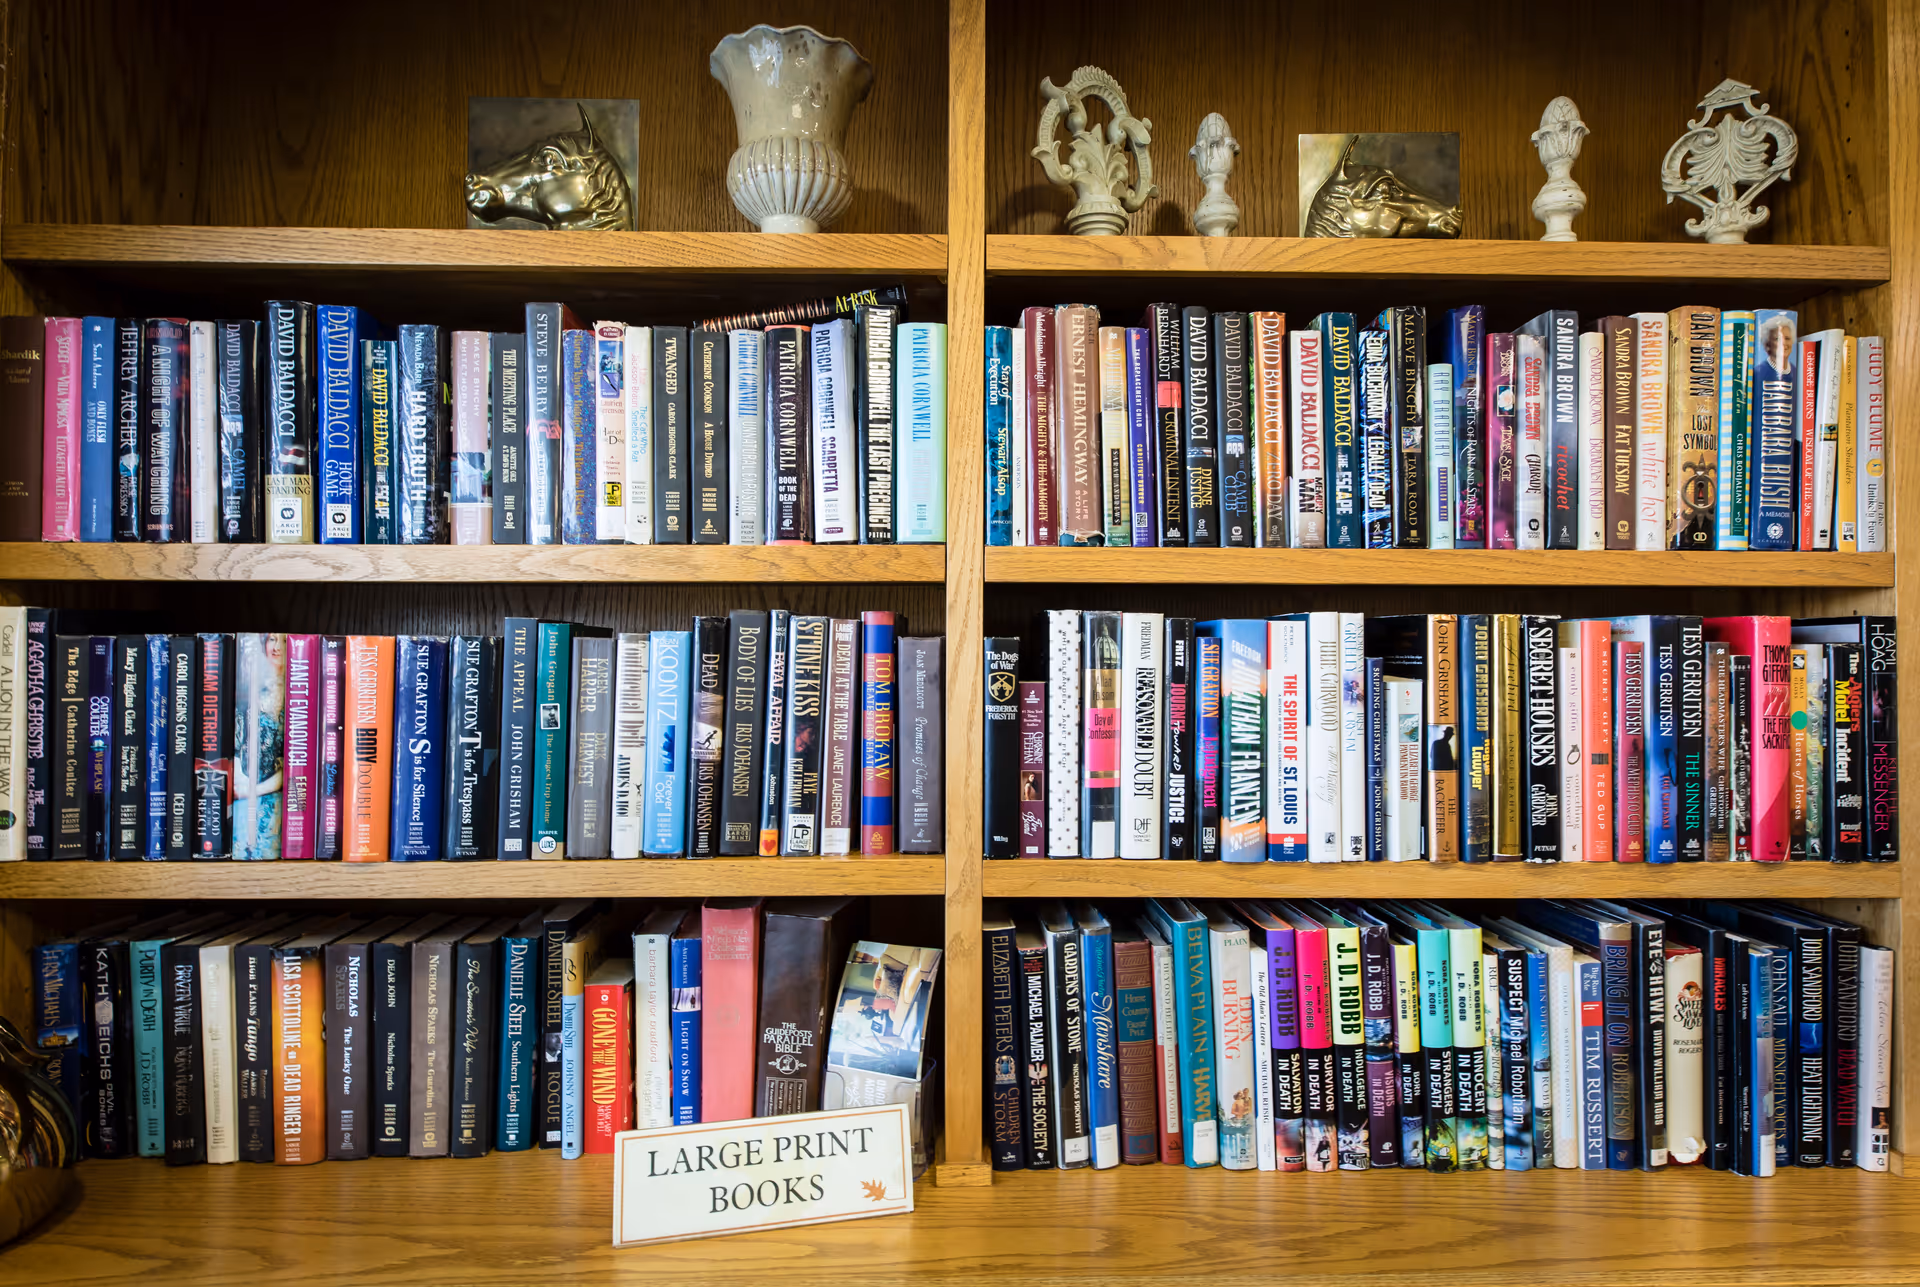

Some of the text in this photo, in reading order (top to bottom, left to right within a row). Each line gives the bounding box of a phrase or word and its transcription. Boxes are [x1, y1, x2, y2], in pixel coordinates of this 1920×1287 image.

[278, 308, 296, 437] DAVID BALDACCI
[327, 311, 350, 449] DAVID BALDACCI
[990, 358, 998, 405] Execution
[1000, 365, 1011, 400] Stay of
[1158, 308, 1170, 379] BERNHARDT
[1170, 320, 1180, 368] WILLIAM
[1190, 317, 1208, 440] DAVID BALDACCI
[1404, 314, 1416, 423] MAEVE BINCHY
[120, 328, 138, 448] JEFFREY ARCHER
[779, 341, 795, 471] PATRICIA CORNWELL
[869, 308, 892, 529] PATRICIA CORNWELL THE LAST PRECINCT
[1072, 314, 1088, 486] ERNEST HEMINGWAY
[1300, 338, 1320, 470] DAVID BALDACCI
[1556, 318, 1574, 510] SANDRA BROWN ricochet
[1615, 328, 1632, 495] SANDRA BROWN FAT TUESDAY
[1692, 416, 1712, 431] LOST
[1869, 344, 1882, 452] JUDY BLUME
[150, 346, 172, 516] A NIGHT OF WATCHING
[410, 391, 426, 500] HARD TRUTH
[998, 428, 1008, 496] Stewart Alsop
[1165, 412, 1180, 522] CRIMINAL INTENT
[1684, 434, 1717, 450] SYMBOL
[1760, 380, 1792, 508] BARBARA BUSH
[266, 477, 310, 486] LAST MAN
[266, 486, 312, 495] STANDING
[326, 460, 338, 497] GAME
[340, 462, 352, 496] HOUR
[779, 477, 797, 485] BOOK
[779, 494, 796, 502] DEAD
[1188, 467, 1202, 508] JUSTICE
[1201, 468, 1212, 506] DIVINE
[657, 645, 679, 720] KOONTZ
[735, 627, 761, 711] BODY OF LIES
[986, 652, 1018, 662] The Dogs
[990, 662, 1015, 670] of War
[1175, 640, 1184, 667] FRITZ
[174, 654, 188, 814] CAROL HIGGINS CLARK ICED
[288, 660, 309, 767] JANET EVANOVICH
[356, 646, 378, 819] TESS GERRITSEN BODY DOUBLE
[409, 646, 430, 821] SUE GRAFTON S is for Silence
[510, 628, 526, 828] THE APPEAL JOHN GRISHAM
[874, 655, 891, 780] TOM BROKAW
[988, 712, 1016, 720] FORSYTH
[1134, 668, 1156, 799] REASONABLE DOUBT
[1284, 674, 1297, 824] THE SPIRIT OF ST. LOUIS
[1683, 625, 1702, 831] TESS GERRITSEN THE SINNER
[1169, 772, 1185, 824] JUSTICE
[1598, 773, 1606, 798] TED
[794, 829, 809, 839] LP
[1064, 942, 1082, 1053] GARDENS OF STONE
[1338, 942, 1361, 1035] J. D. ROBB
[1714, 957, 1726, 1011] MIRACLES
[1800, 937, 1823, 1021] JOHN SANDFORD
[284, 956, 302, 1136] LISA SCOTTOLINE DEAD RINGER
[506, 944, 528, 1113] DANIELLE STEEL Southern Lights
[592, 1008, 617, 1048] GONE
[1028, 975, 1048, 1151] MICHAEL PALMER THE SOCIETY
[1508, 959, 1526, 1124] SUSPECT Michael Robotham
[592, 1066, 617, 1104] WIND
[1278, 1058, 1291, 1111] IN DEATH
[1291, 1053, 1302, 1114] SALVATION
[1473, 1050, 1485, 1114] INNOCENT
[1586, 1030, 1603, 1163] TIM RUSSERT
[1802, 1057, 1823, 1143] HEAT LIGHTNING
[648, 1127, 874, 1177] LARGE PRINT
[709, 1174, 825, 1214] BOOKS
